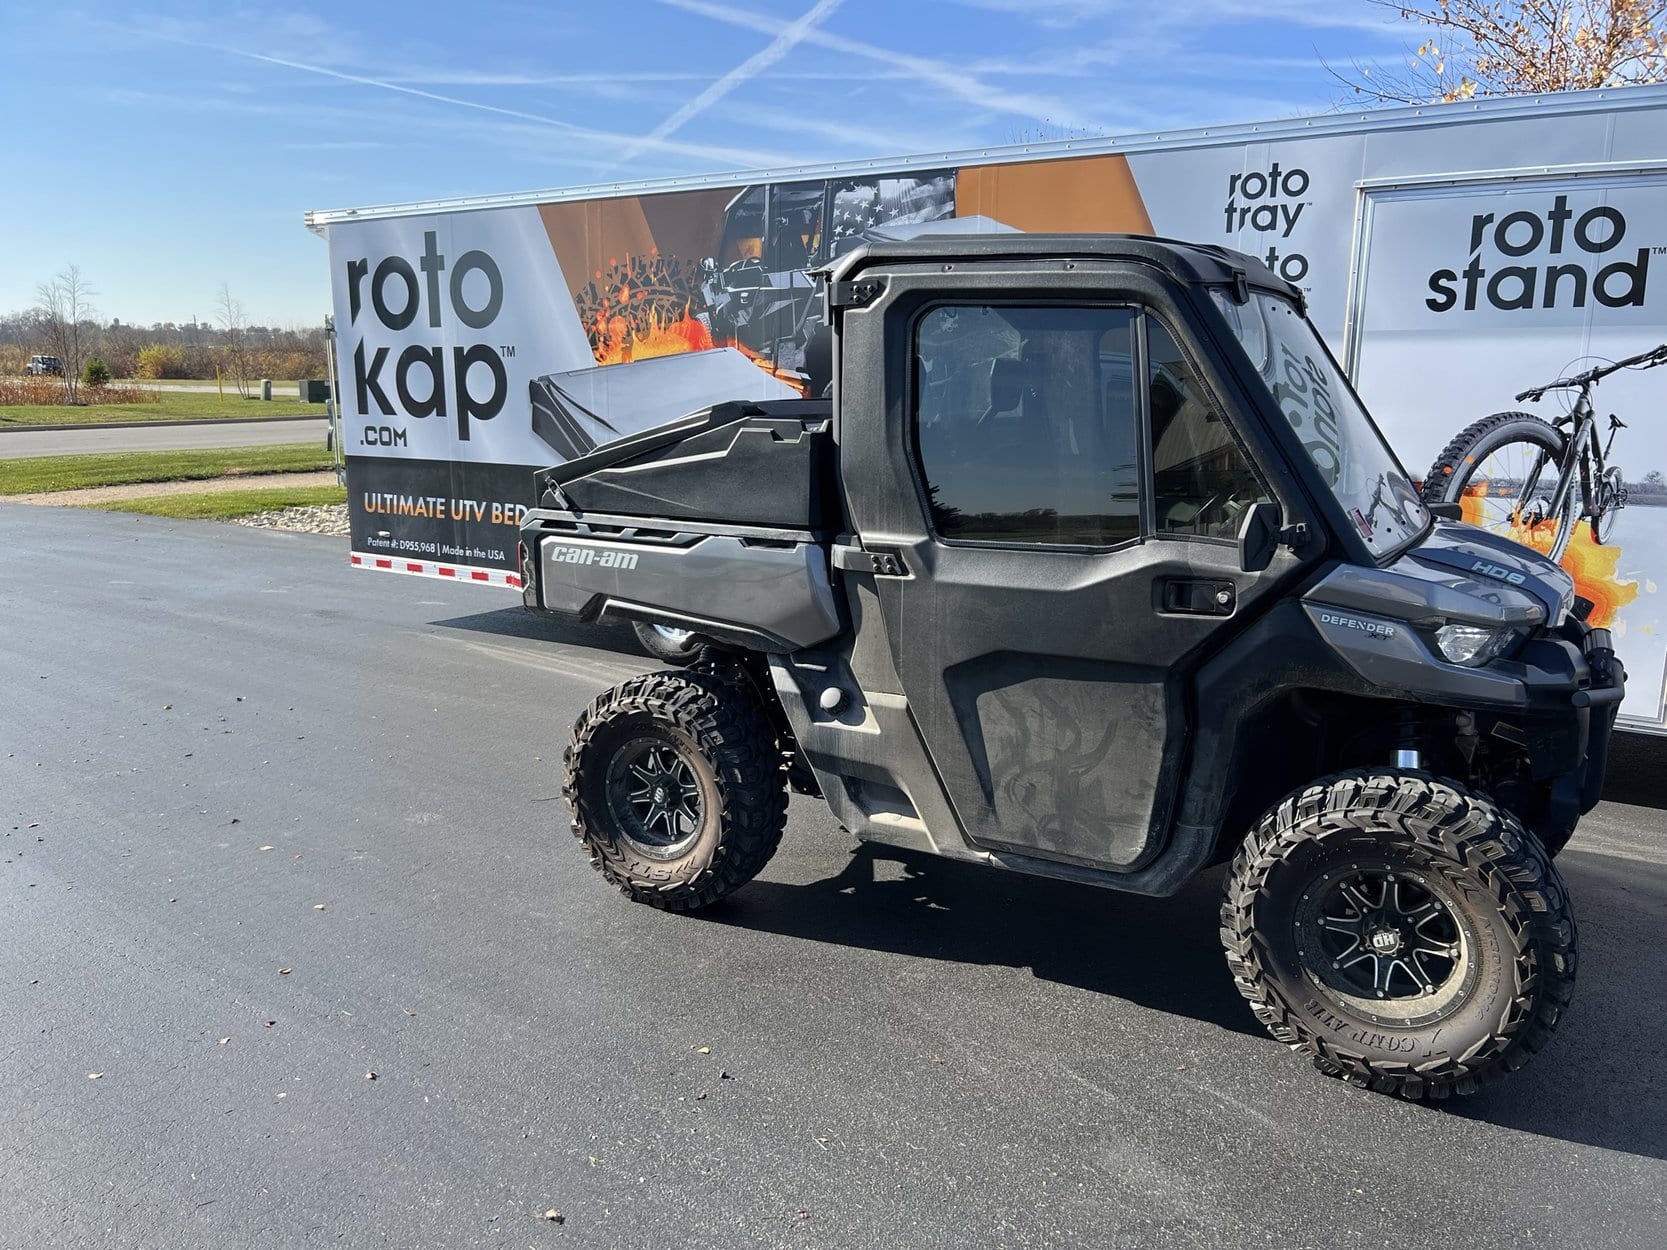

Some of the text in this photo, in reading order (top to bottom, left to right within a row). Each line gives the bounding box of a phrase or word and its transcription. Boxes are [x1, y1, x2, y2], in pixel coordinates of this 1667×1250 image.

[1229, 162, 1310, 200] roto
[1224, 197, 1305, 238] tray
[1470, 195, 1627, 257] roto
[347, 230, 503, 331] roto
[1425, 247, 1650, 312] stand
[353, 335, 508, 441] kap
[360, 425, 408, 448] .COM
[364, 492, 528, 526] ULTIMATE UTV BED
[367, 537, 390, 548] Patent
[399, 540, 436, 554] D955,968
[442, 545, 464, 556] Made
[465, 546, 473, 557] in
[473, 548, 487, 559] the
[488, 549, 506, 561] USA
[551, 545, 640, 570] can-am
[1471, 560, 1527, 585] HD8
[1320, 613, 1395, 636] DEFENDER
